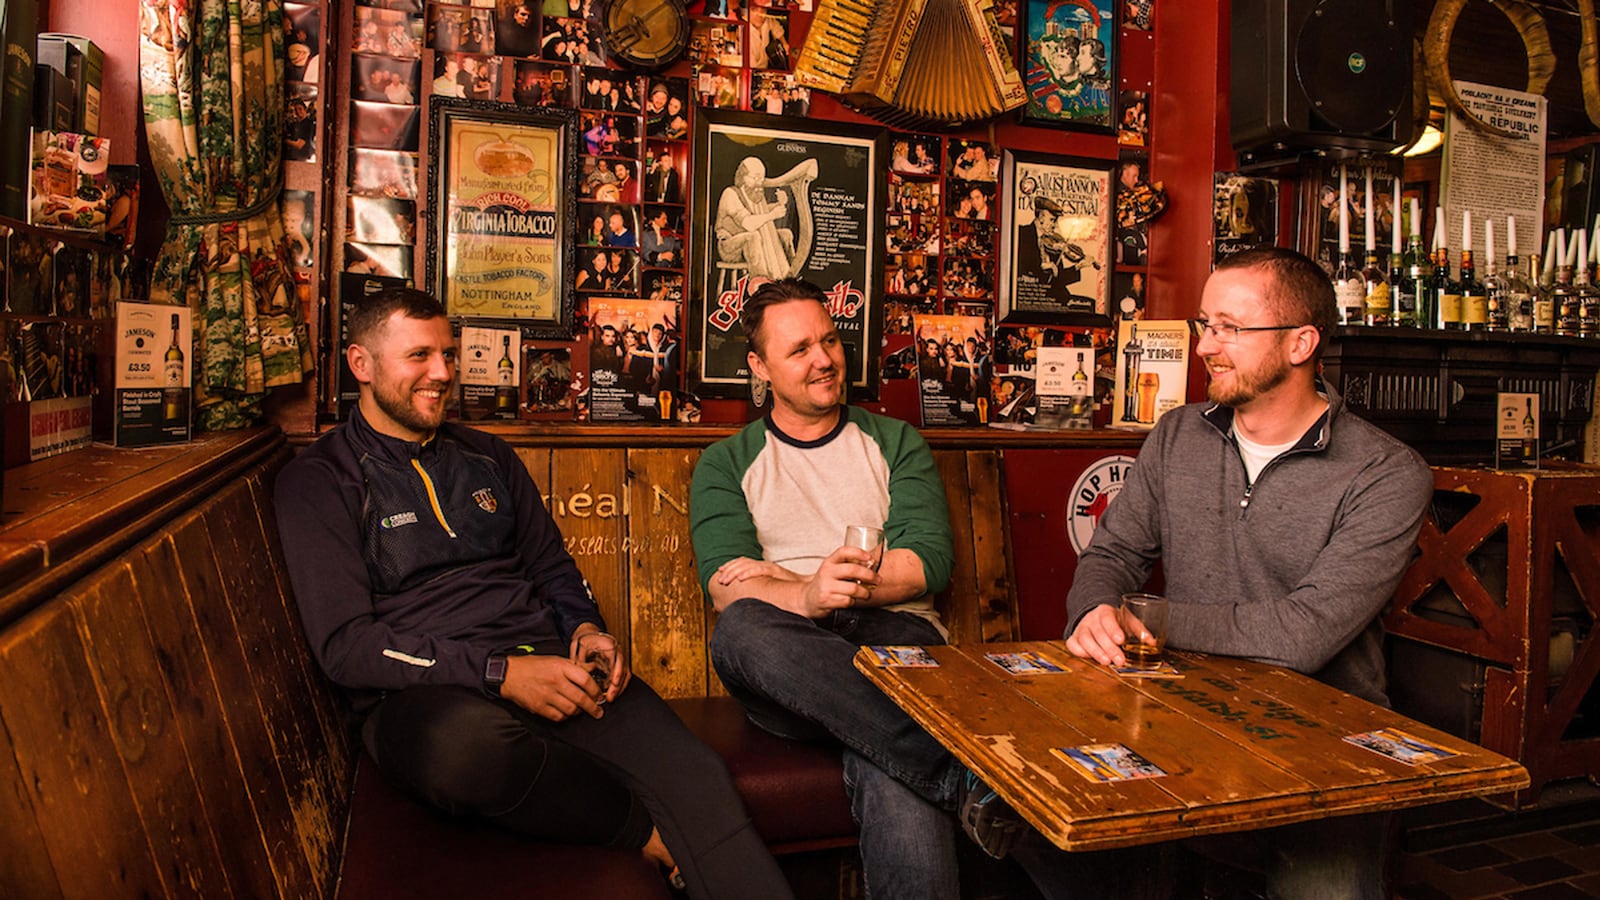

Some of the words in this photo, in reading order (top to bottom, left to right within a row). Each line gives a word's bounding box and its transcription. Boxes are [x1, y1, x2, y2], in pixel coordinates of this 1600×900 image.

[894, 10, 918, 61] PIETRO
[1490, 116, 1540, 133] REPUBLIC
[479, 192, 500, 209] RICH
[502, 193, 528, 211] COOL
[523, 247, 552, 264] Sons
[483, 269, 514, 281] TOBACCO
[516, 269, 546, 282] FACTORY
[124, 327, 155, 339] JAMESON
[834, 321, 860, 330] TIVAL
[1147, 332, 1184, 340] MAGNERS
[1147, 348, 1183, 359] TIME
[128, 363, 151, 371] £3.50
[1076, 474, 1101, 517] HOP
[578, 535, 617, 555] seats
